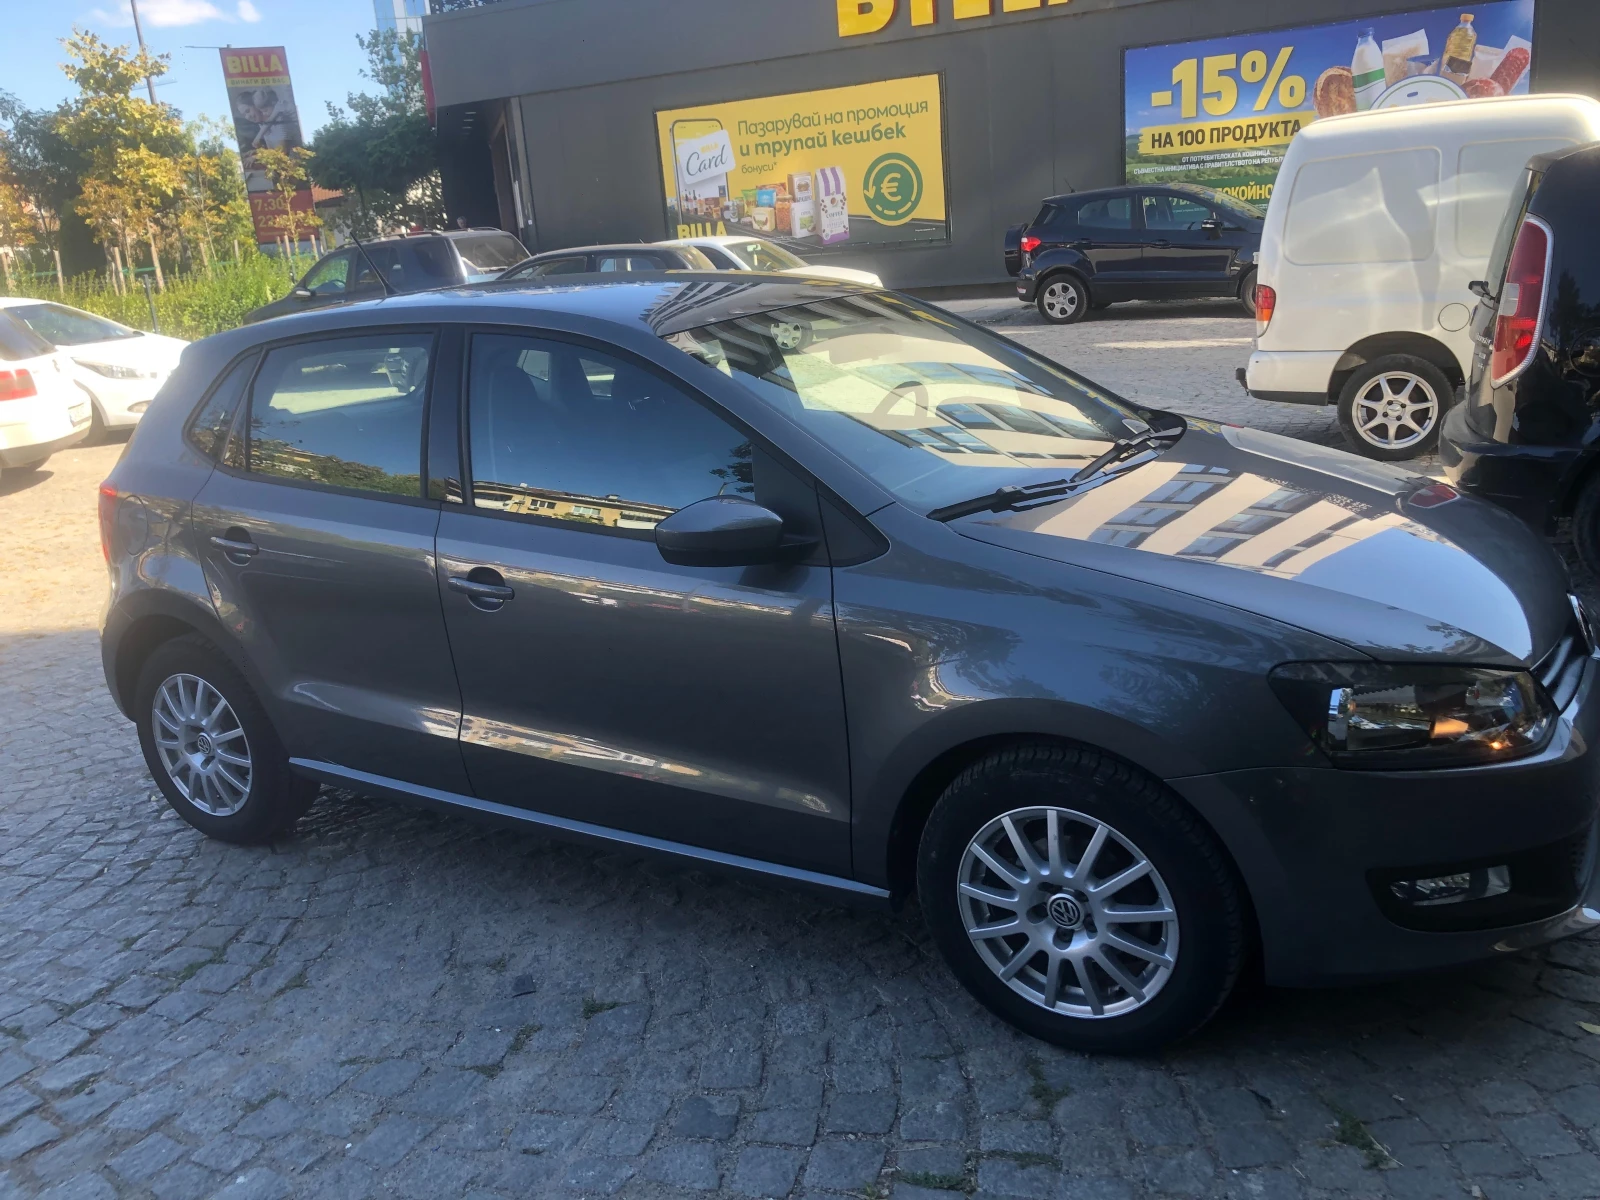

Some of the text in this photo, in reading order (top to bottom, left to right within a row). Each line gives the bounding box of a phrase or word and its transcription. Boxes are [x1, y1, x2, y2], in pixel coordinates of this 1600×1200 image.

[226, 54, 284, 74] BILLA
[1151, 46, 1306, 118] -15%
[737, 100, 929, 137] Пазарувай на промоция
[739, 121, 907, 158] и трупай кешбек
[1151, 120, 1301, 149] НА 100 ПРОДУКТА
[686, 144, 728, 177] Card
[1133, 167, 1164, 175] СЪВМЕСТНА
[1165, 164, 1199, 172] ИНИЦИАТИВА
[1204, 159, 1253, 169] ПРАВИТЕЛСТВОТО
[1261, 156, 1284, 164] РЕПУБЛ
[1190, 152, 1242, 162] ПОТРЕБИТЕЛСКАТА
[1242, 149, 1271, 157] КОШНИЦА
